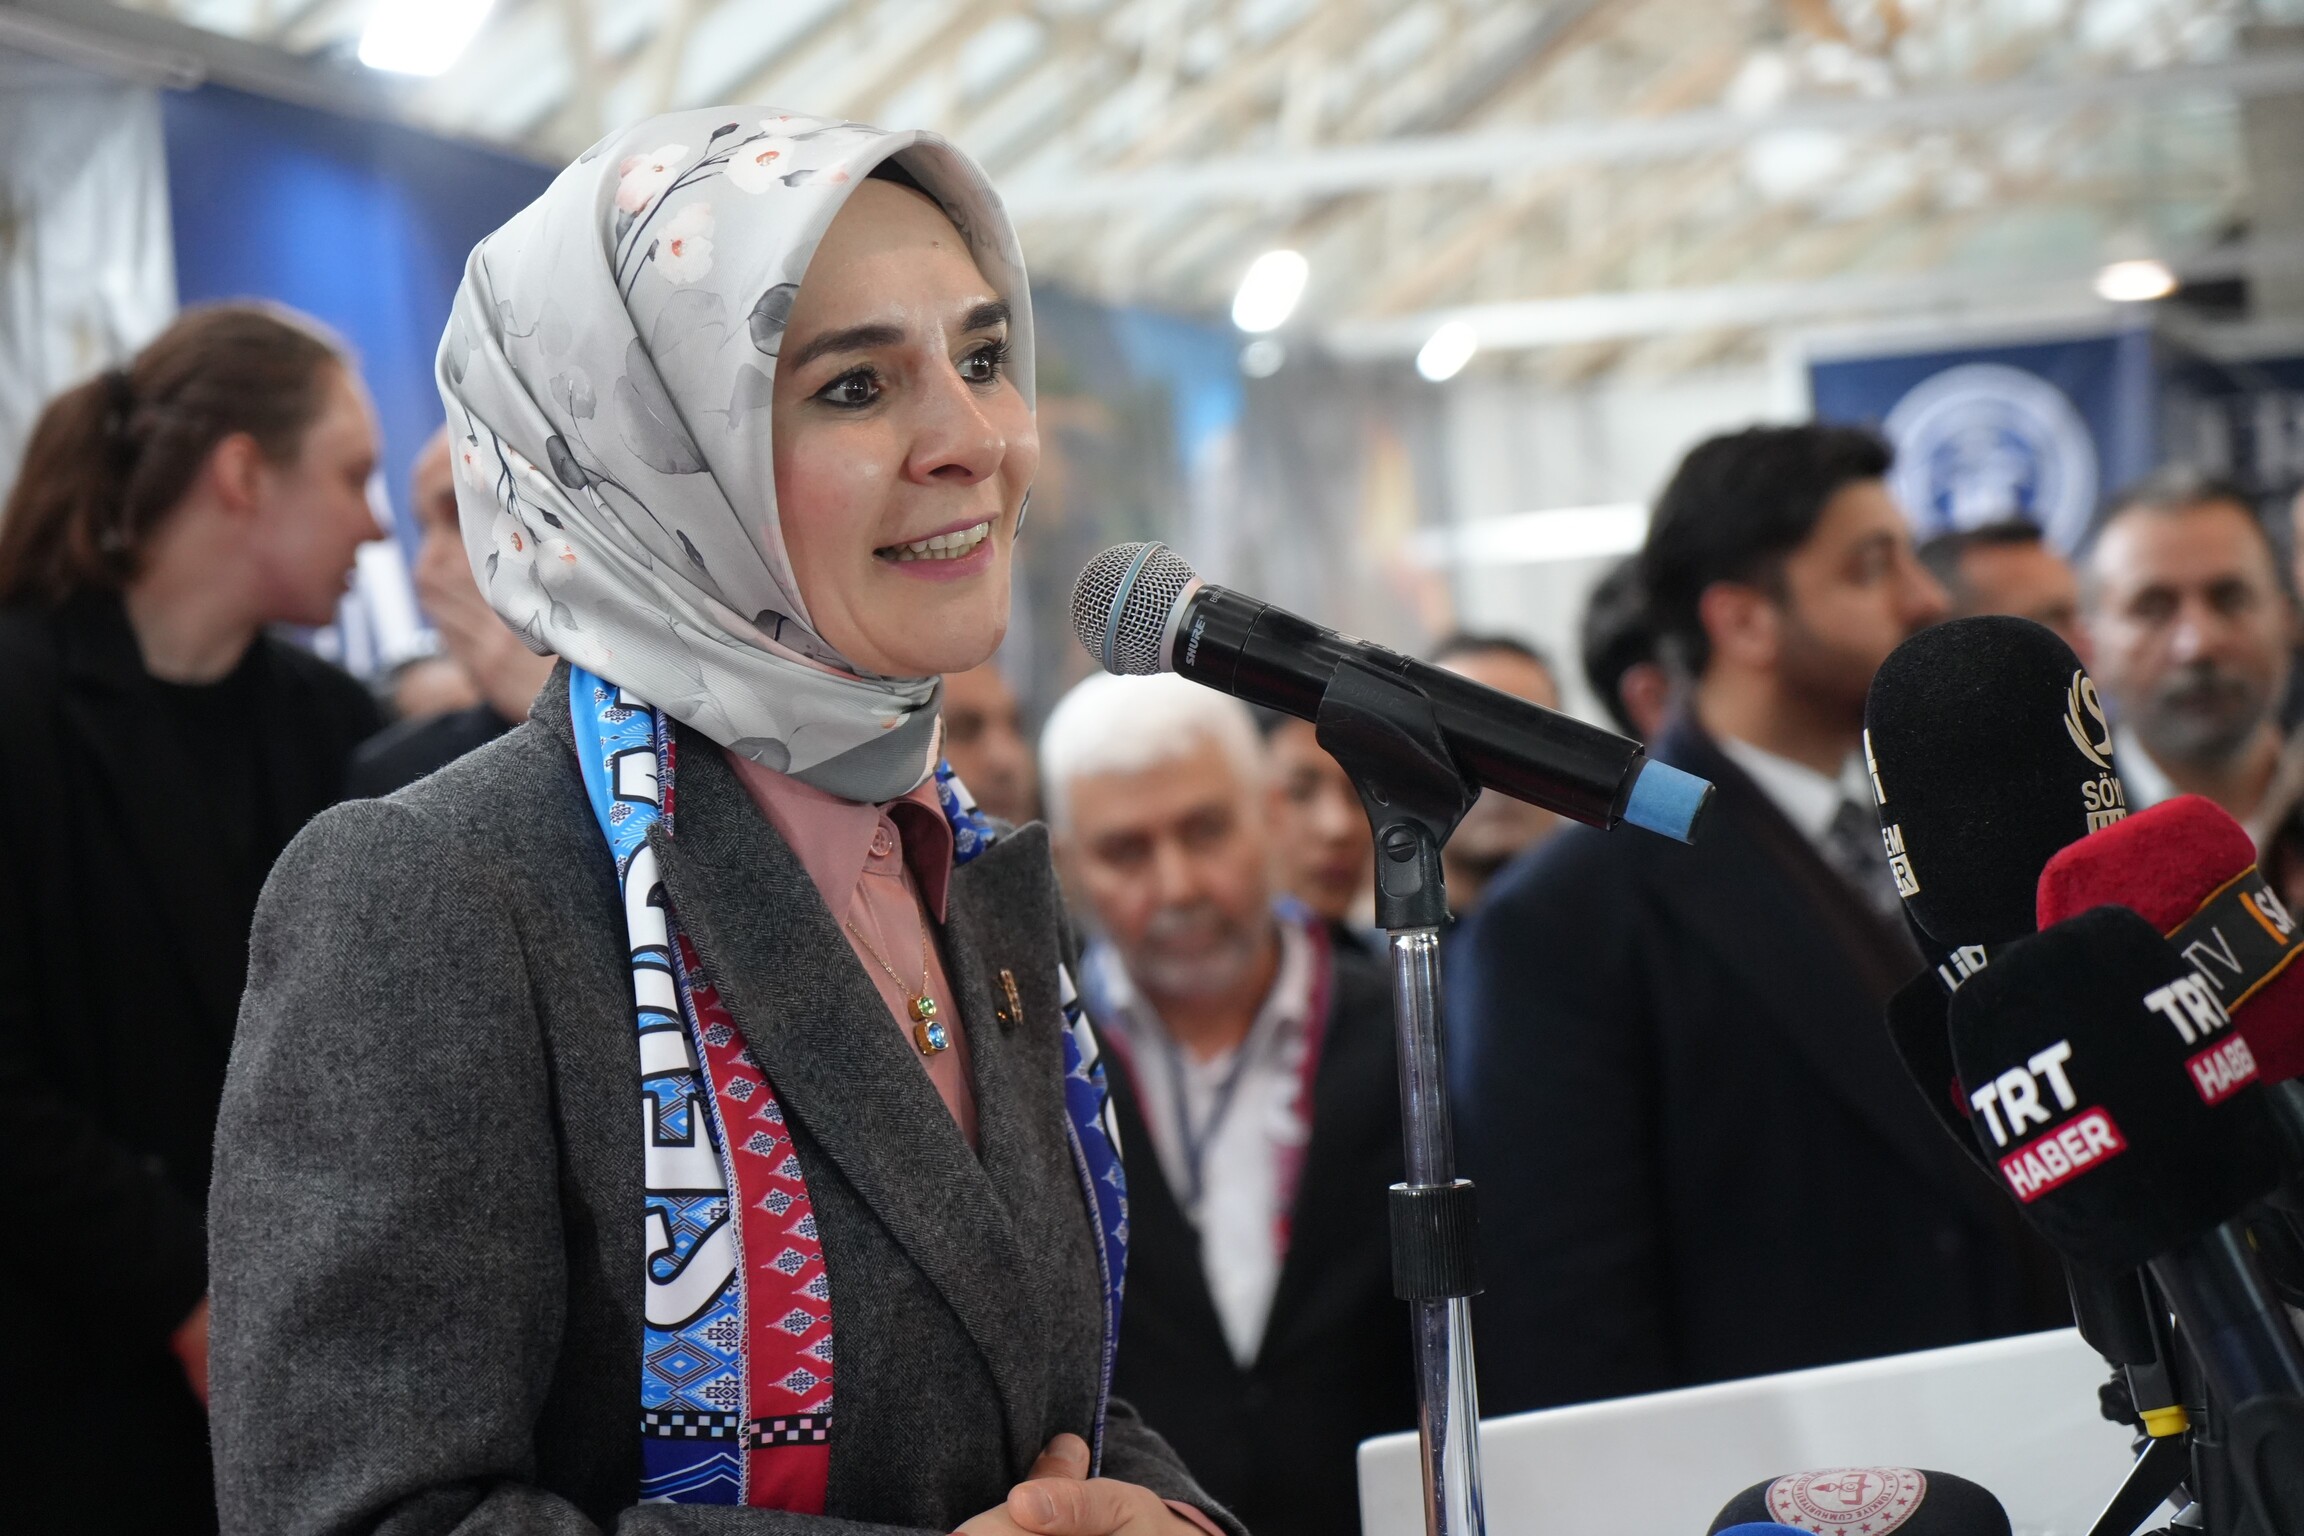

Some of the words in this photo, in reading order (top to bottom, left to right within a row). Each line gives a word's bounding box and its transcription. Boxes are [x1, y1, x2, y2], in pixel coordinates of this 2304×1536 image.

[1185, 618, 1206, 667] SHURE
[2181, 924, 2243, 990] TV
[1970, 1038, 2078, 1148] TRT
[2003, 1113, 2120, 1199] HABER
[1855, 1491, 1892, 1519] TÜRKİYE
